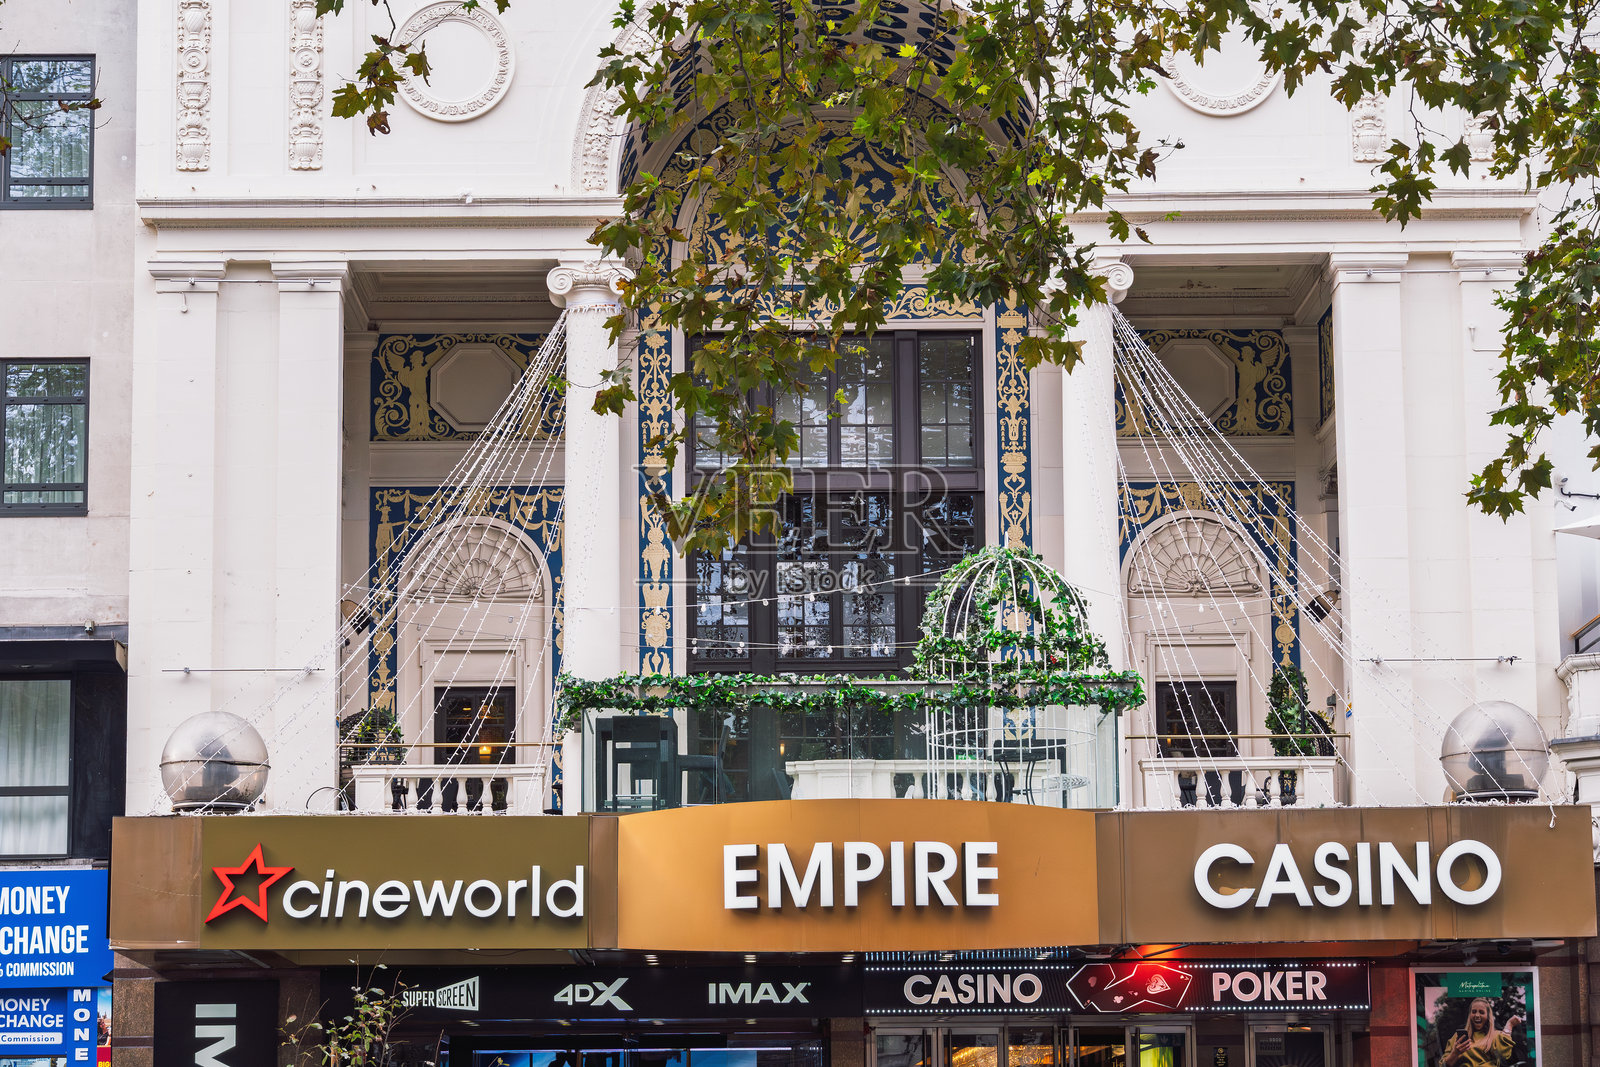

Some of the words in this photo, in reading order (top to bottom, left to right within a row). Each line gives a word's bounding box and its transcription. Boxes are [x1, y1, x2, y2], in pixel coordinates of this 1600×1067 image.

[723, 841, 999, 909] EMPIRE
[1194, 840, 1502, 909] CASINO
[282, 865, 584, 918] cineworld
[0, 925, 89, 955] CHANGE
[6, 962, 74, 977] COMMISSION
[403, 991, 435, 1007] SUPER
[438, 981, 476, 1007] SCREEN
[554, 978, 633, 1010] 4DX
[708, 983, 811, 1004] IMAX
[903, 973, 1043, 1005] CASINO
[1212, 971, 1327, 1001] POKER
[1, 1034, 55, 1042] Commission
